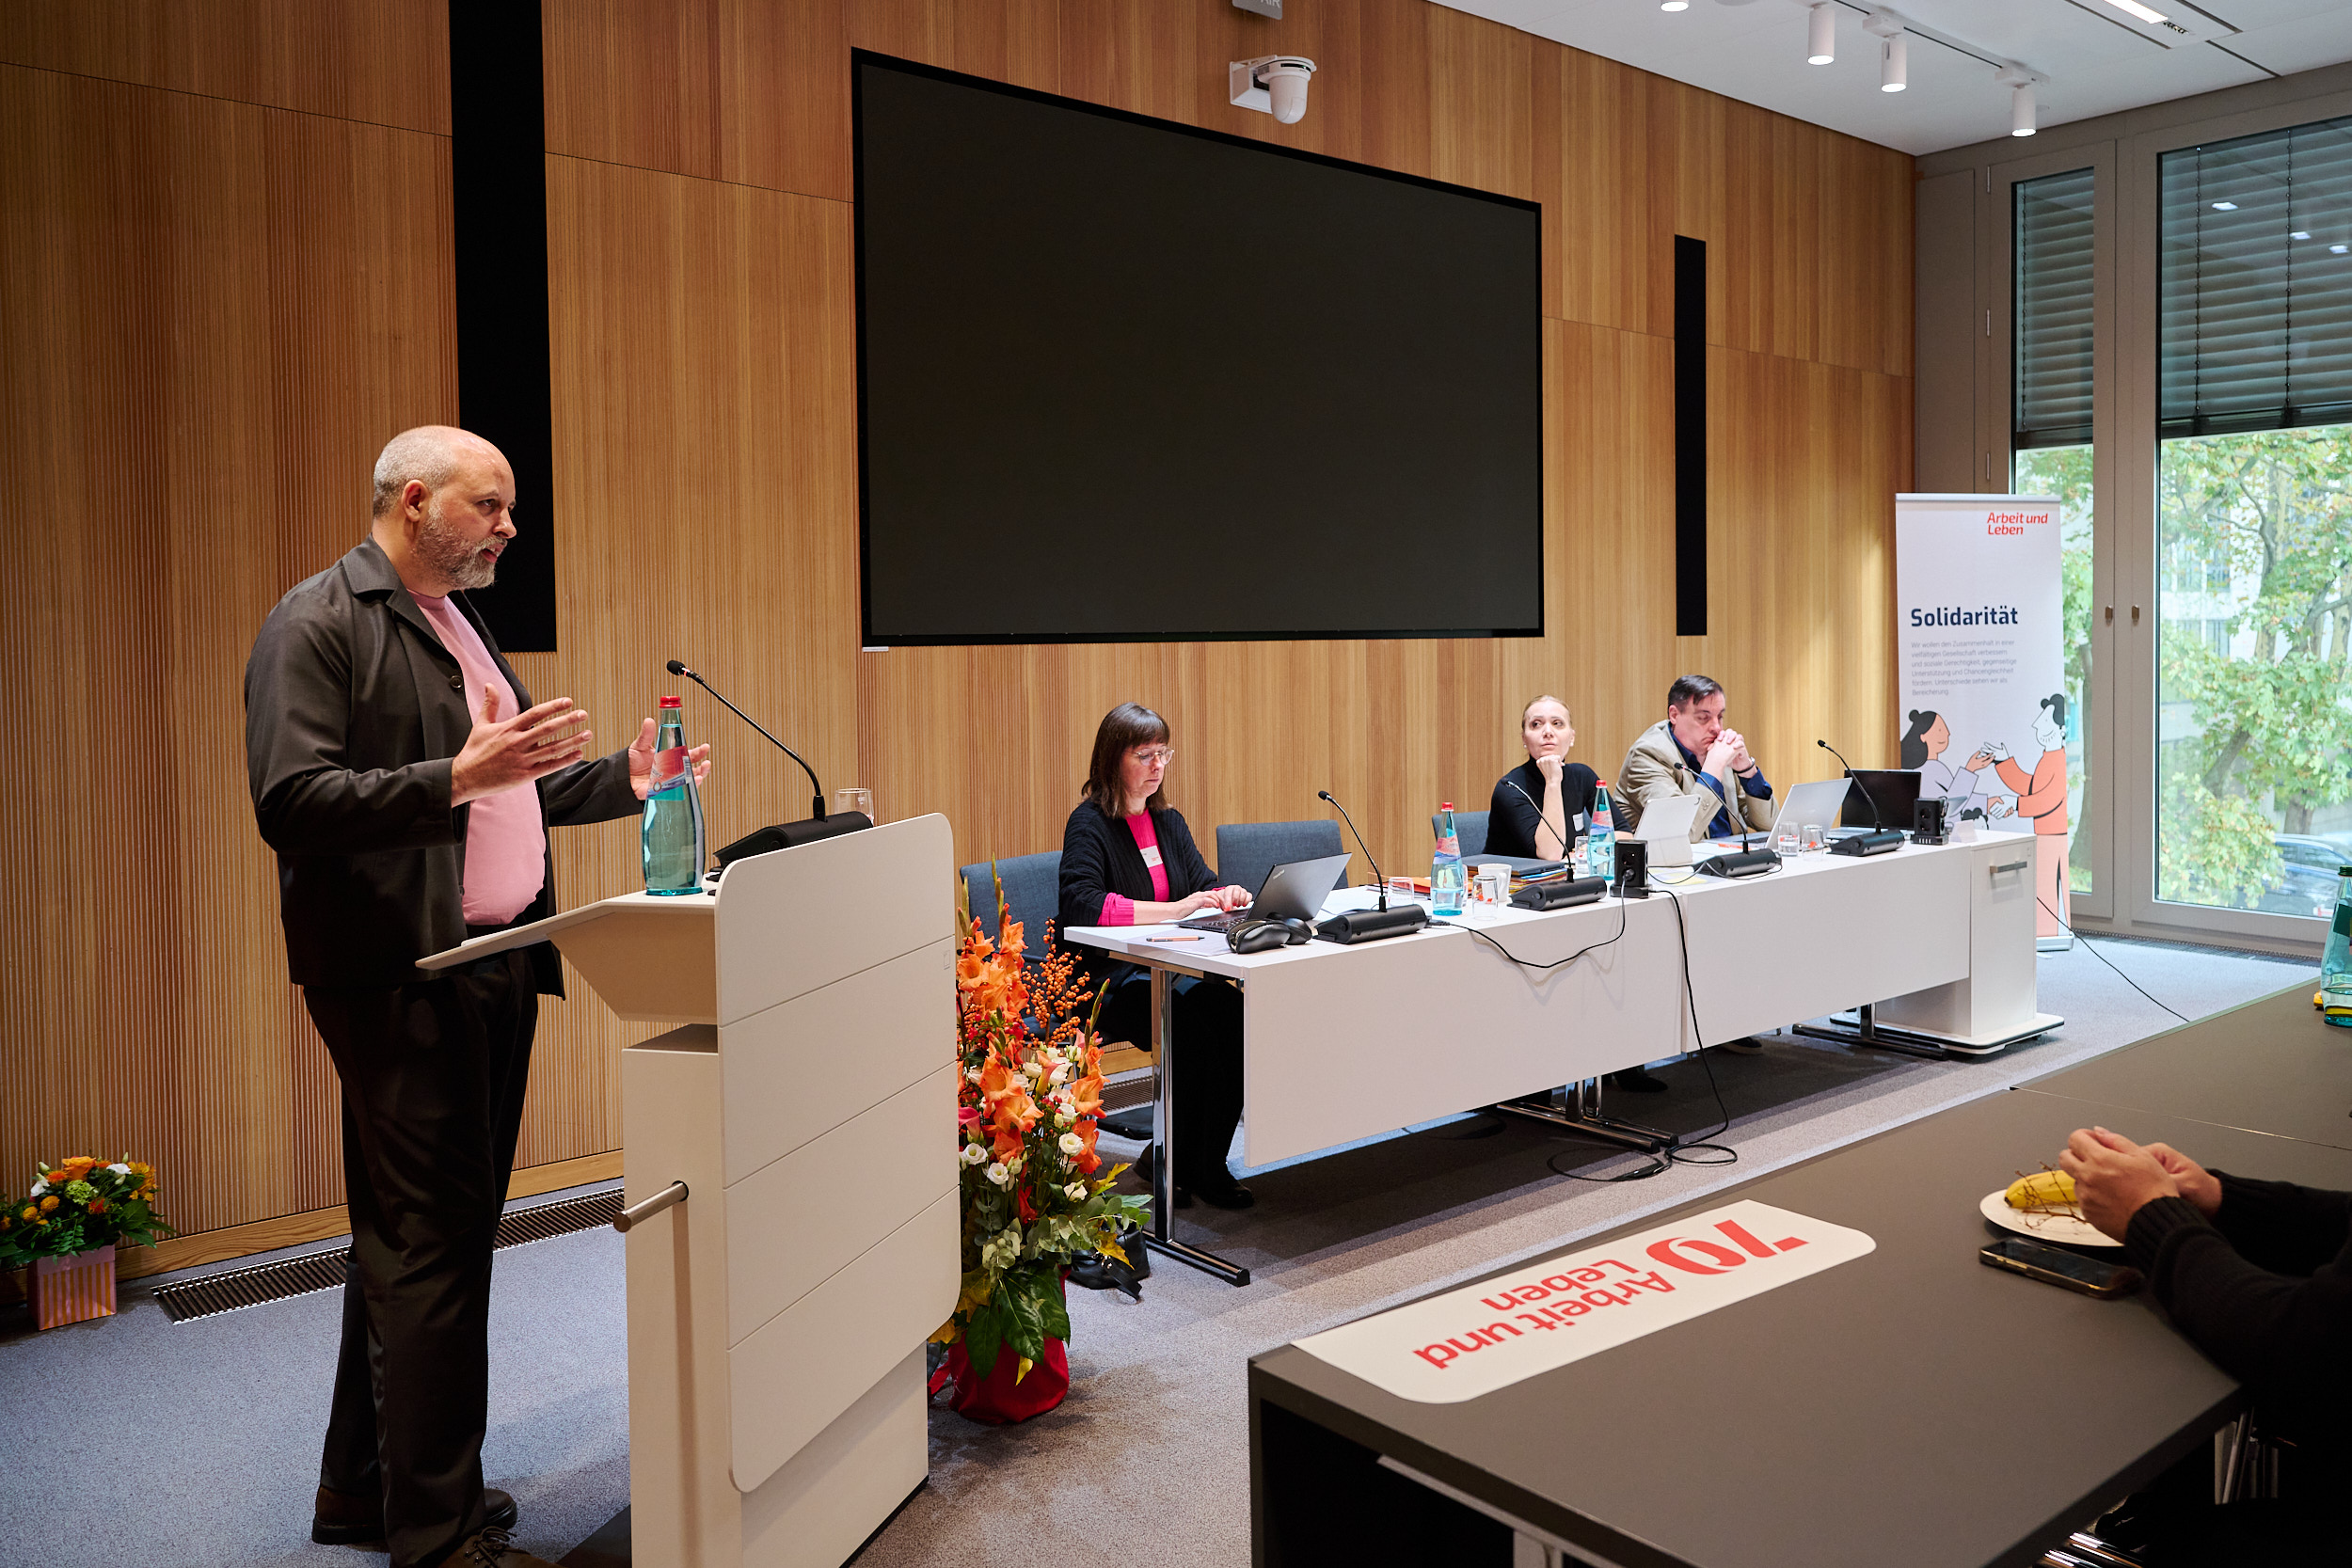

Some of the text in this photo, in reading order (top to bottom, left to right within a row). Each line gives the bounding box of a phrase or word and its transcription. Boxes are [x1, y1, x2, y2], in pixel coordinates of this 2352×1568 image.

[1987, 512, 2048, 524] Arbeit und
[1988, 524, 2024, 535] Leben
[1911, 605, 2018, 627] Solidarität
[1912, 669, 1951, 677] Unterstützung
[1480, 1259, 1640, 1311] Leben
[1413, 1271, 1677, 1370] Arbeit und
